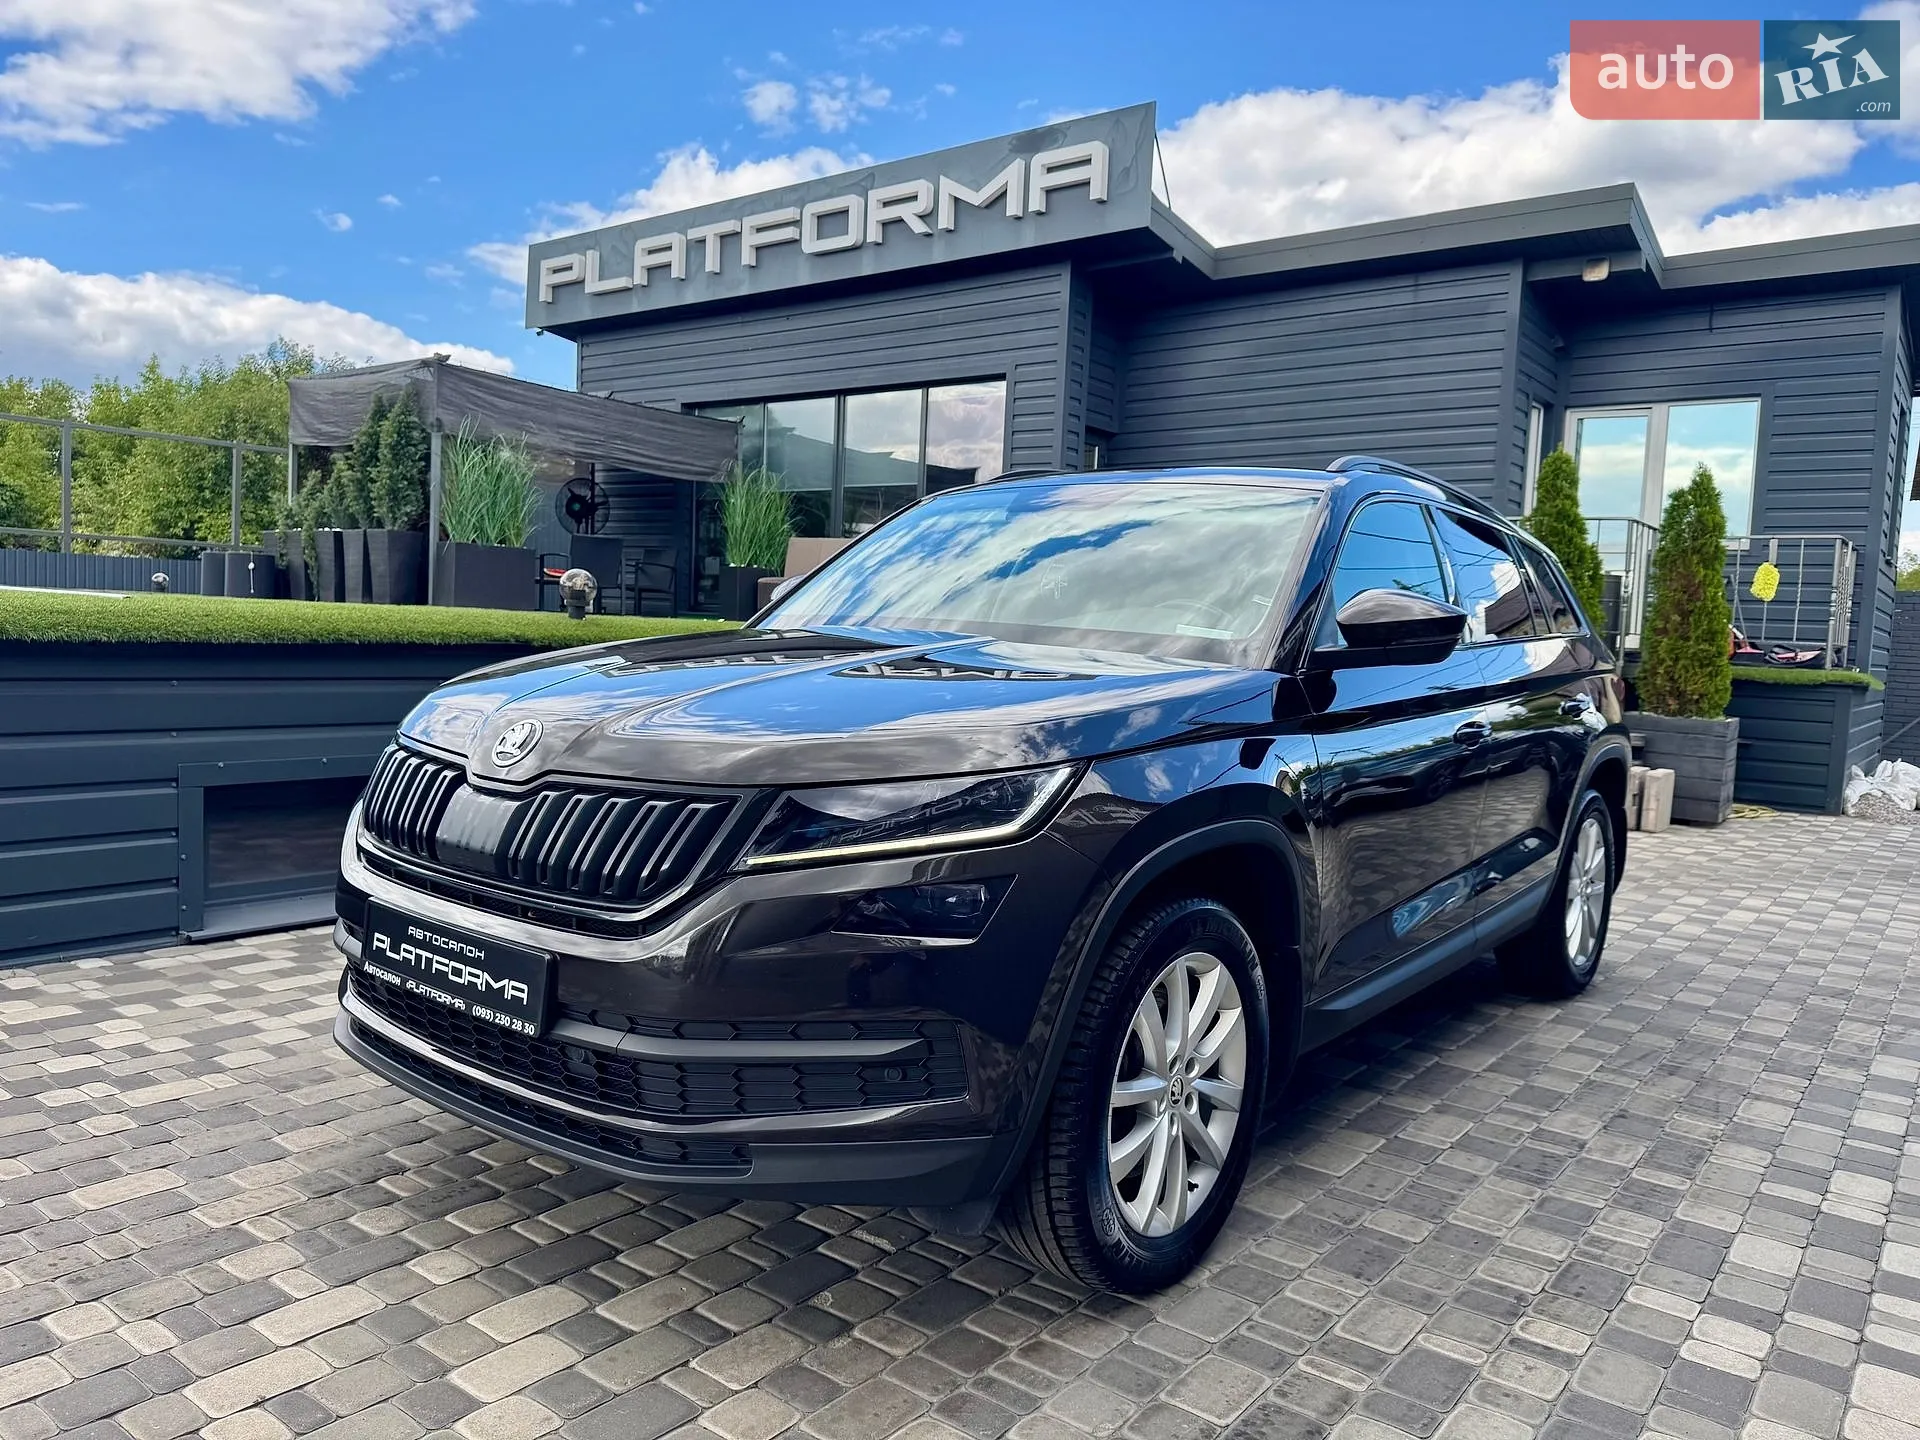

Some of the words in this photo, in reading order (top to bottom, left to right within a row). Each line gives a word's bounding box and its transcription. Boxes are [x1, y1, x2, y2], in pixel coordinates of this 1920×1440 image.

[539, 139, 1110, 304] PLATFORMA
[372, 932, 529, 1006] PLATFORMA
[407, 925, 485, 961] АВТОСАЛОН
[363, 960, 402, 987] Автосалон
[472, 1004, 494, 1023] (093)
[494, 1012, 511, 1027] 230
[511, 1018, 523, 1032] 28
[523, 1022, 535, 1036] 30
